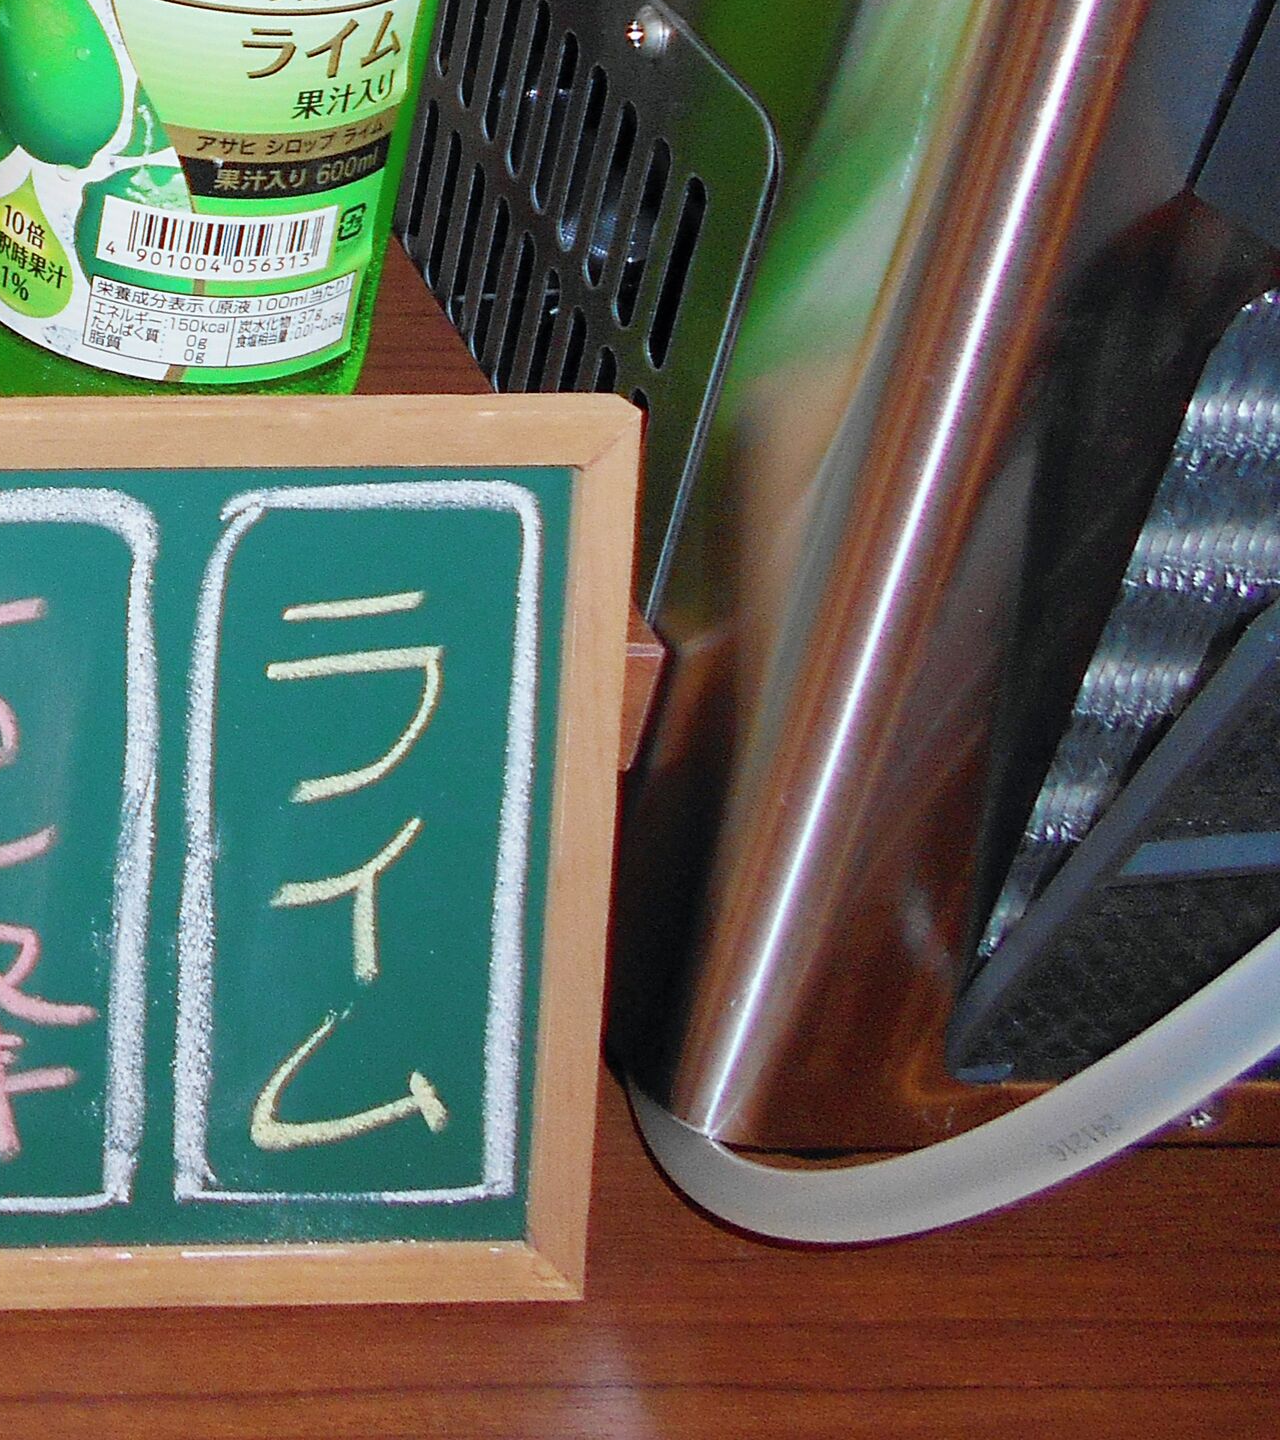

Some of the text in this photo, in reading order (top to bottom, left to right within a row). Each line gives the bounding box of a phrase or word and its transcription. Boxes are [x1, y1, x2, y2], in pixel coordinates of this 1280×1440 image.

[241, 10, 403, 80] ライム
[292, 69, 395, 120] 果汁入り
[196, 121, 385, 157] アサヒ シロップ ライム
[214, 146, 379, 192] 果汁入り 600ml
[5, 204, 46, 250] 10倍
[2, 264, 30, 302] 1%
[251, 589, 449, 1152] ライム
